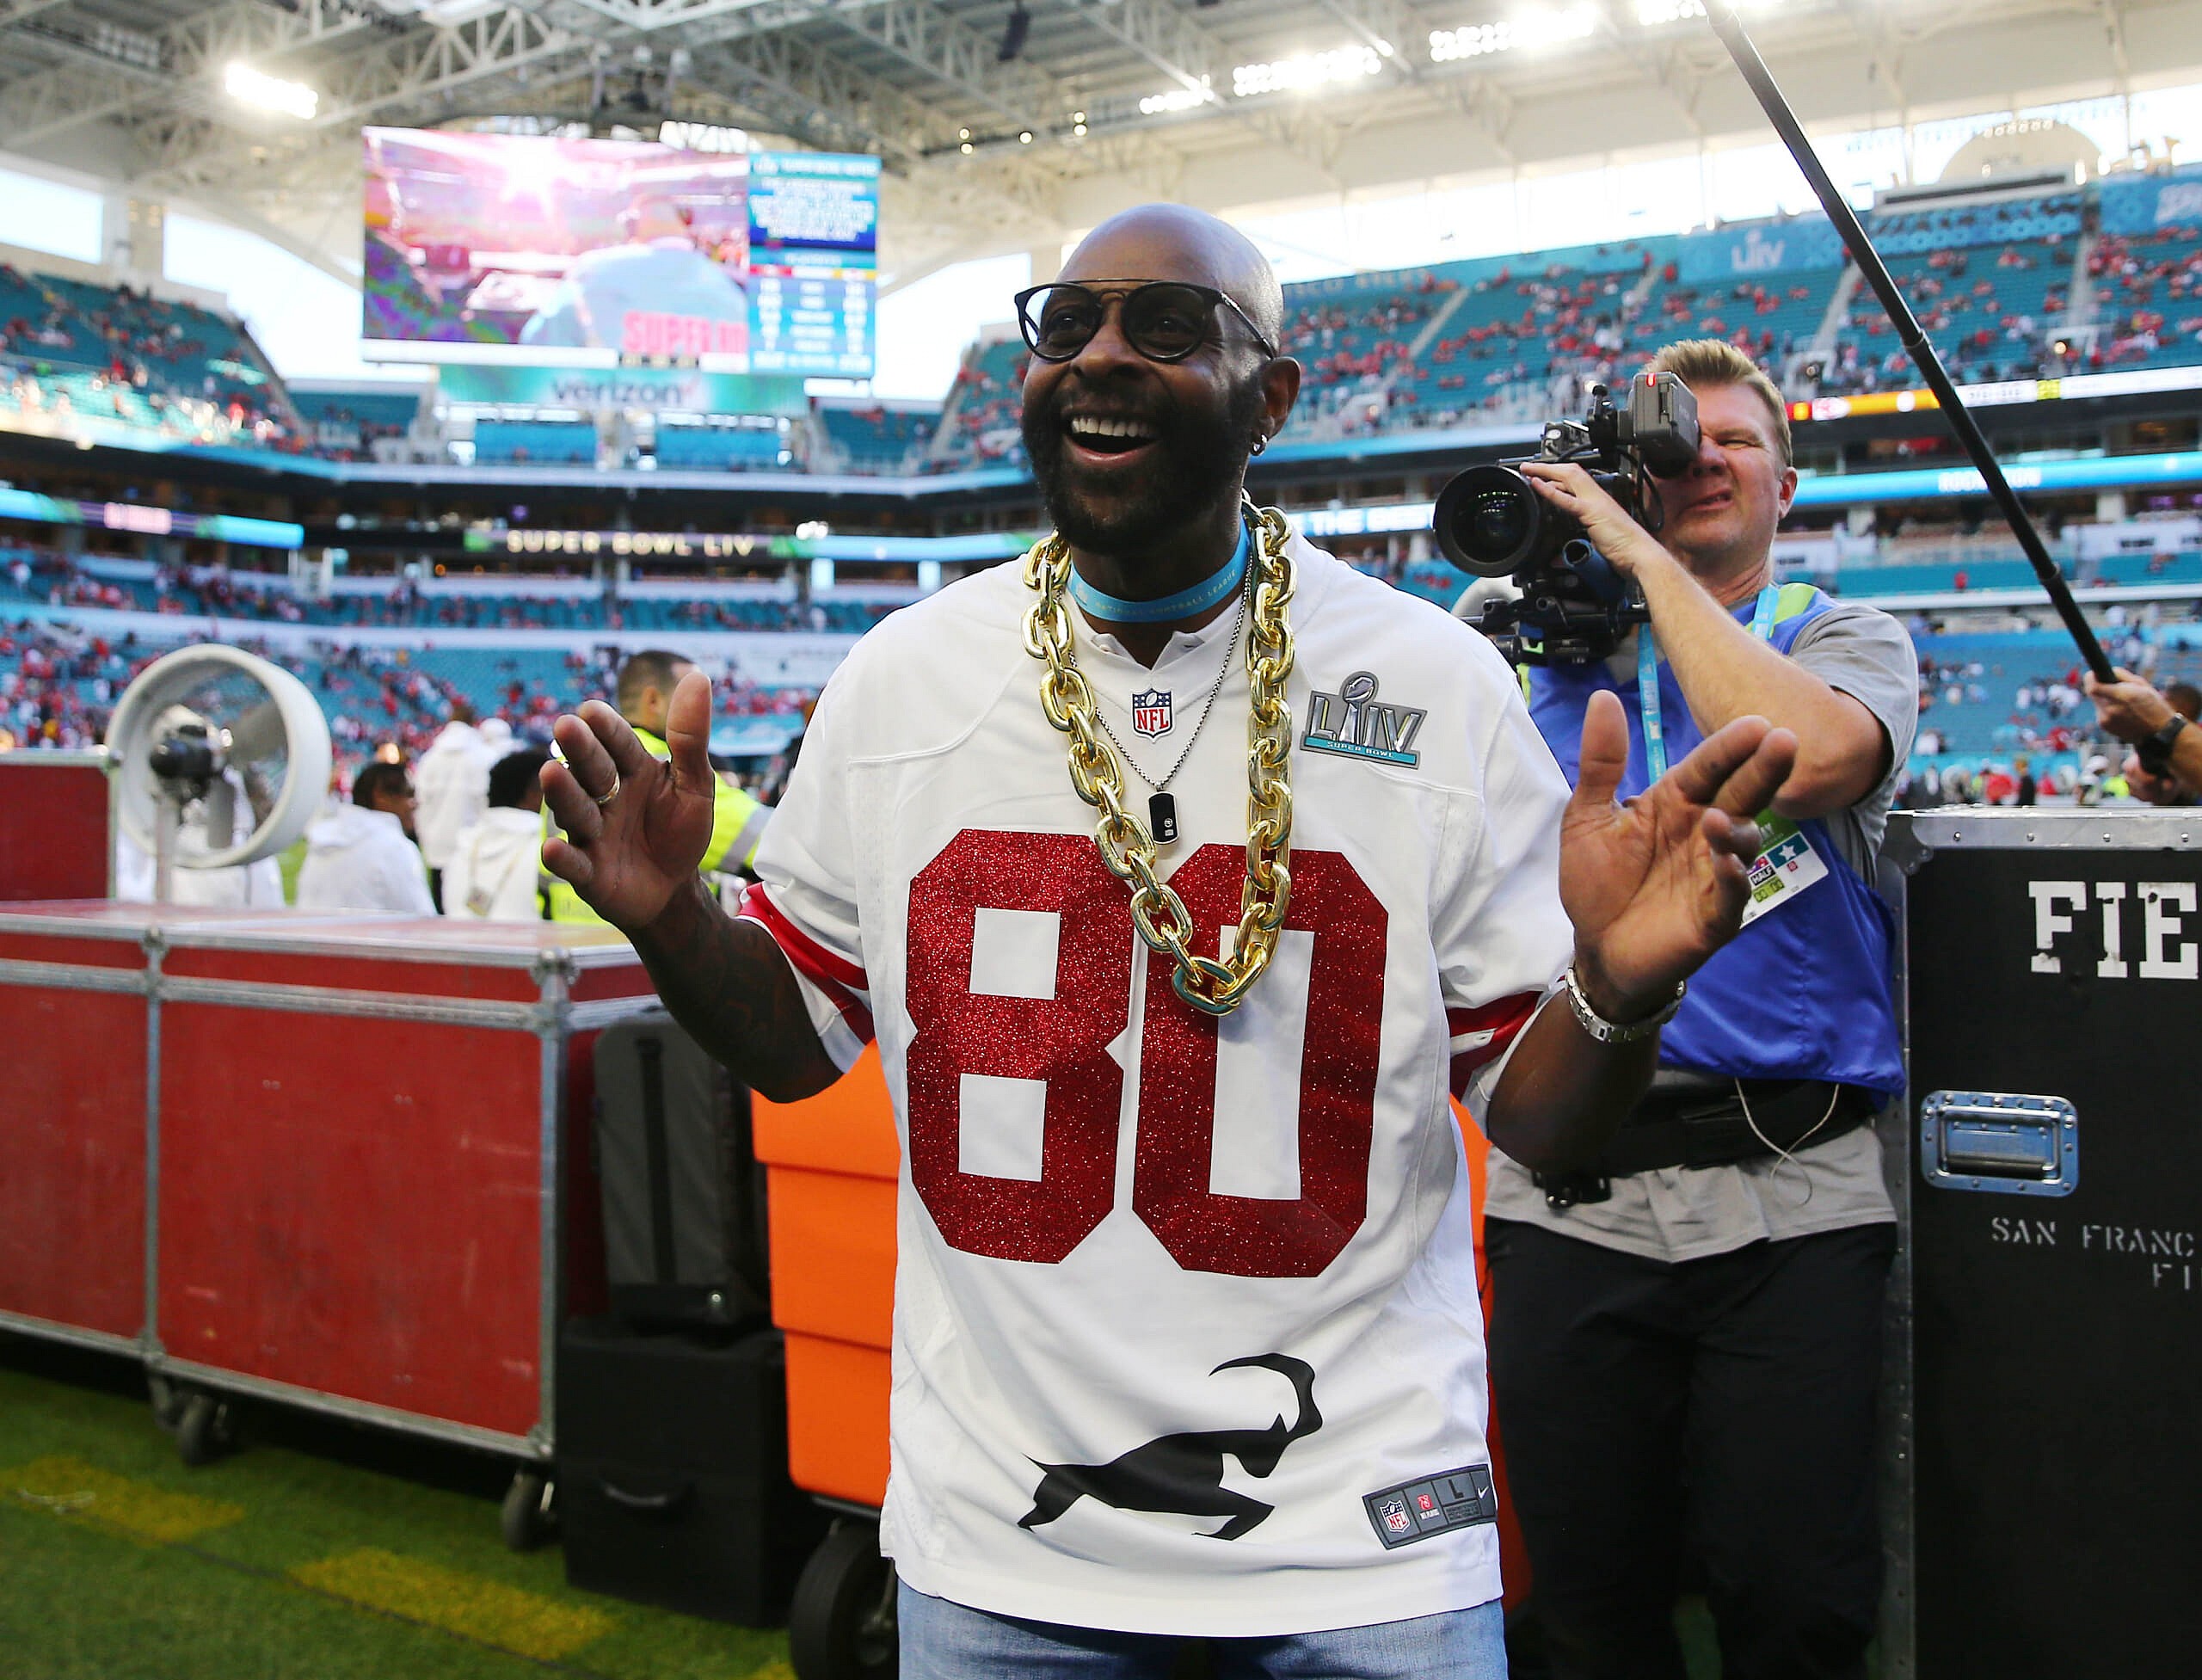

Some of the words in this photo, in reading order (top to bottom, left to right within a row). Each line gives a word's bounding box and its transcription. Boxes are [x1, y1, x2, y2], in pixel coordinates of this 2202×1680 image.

[550, 378, 683, 403] verizon
[507, 529, 600, 553] SUPER
[612, 532, 692, 556] BOWL
[704, 534, 755, 557] LIV
[1207, 569, 1236, 596] LEAGUE
[1135, 709, 1169, 732] NFL
[1327, 741, 1361, 751] SUPER
[1366, 748, 1393, 758] BOWL
[2028, 881, 2199, 980] FIE
[906, 828, 1388, 1278] 80
[1991, 1216, 2056, 1245] SAN
[2082, 1225, 2194, 1257] FRANC
[2152, 1263, 2202, 1290] FI
[1448, 1479, 1465, 1499] L
[1387, 1513, 1407, 1529] NFL
